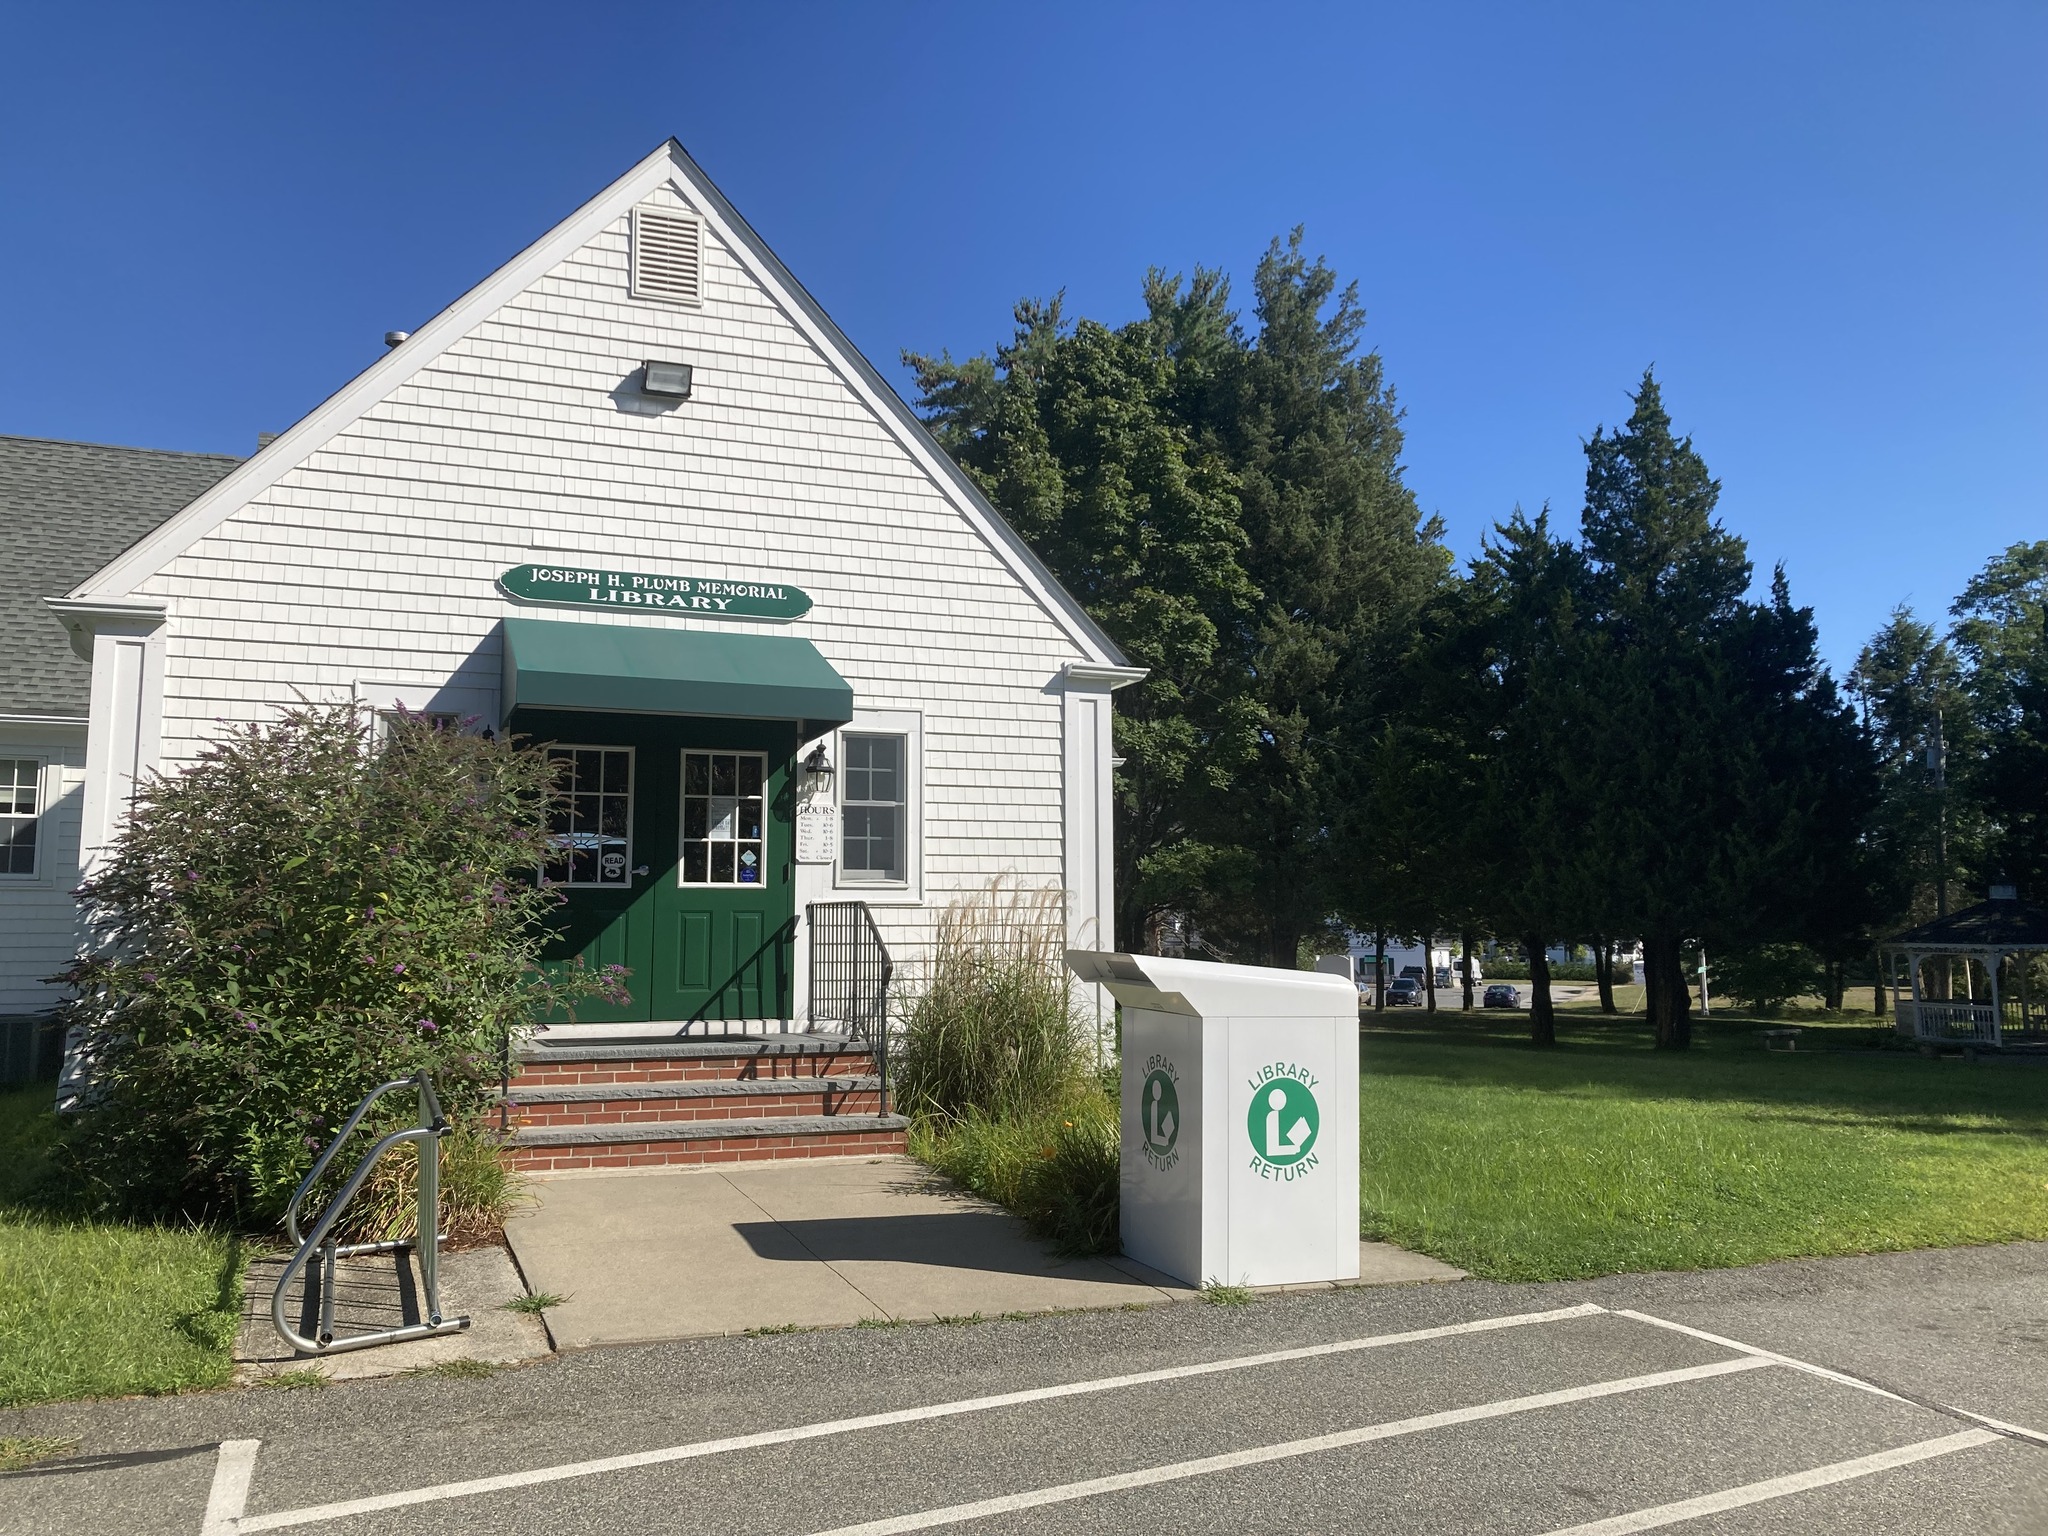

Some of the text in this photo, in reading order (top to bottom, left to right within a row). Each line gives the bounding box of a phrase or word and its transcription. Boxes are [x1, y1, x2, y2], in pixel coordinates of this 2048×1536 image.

[530, 568, 788, 600] JOSEPH H. PLUMB MEMORIAL
[589, 587, 733, 611] LIBRARY
[800, 806, 835, 815] HOURS
[605, 857, 624, 865] READ
[1142, 1054, 1180, 1084] LIBRARY
[1248, 1062, 1319, 1091] LIBRARY
[1142, 1140, 1180, 1172] RETURN
[1249, 1152, 1320, 1182] RETURN
